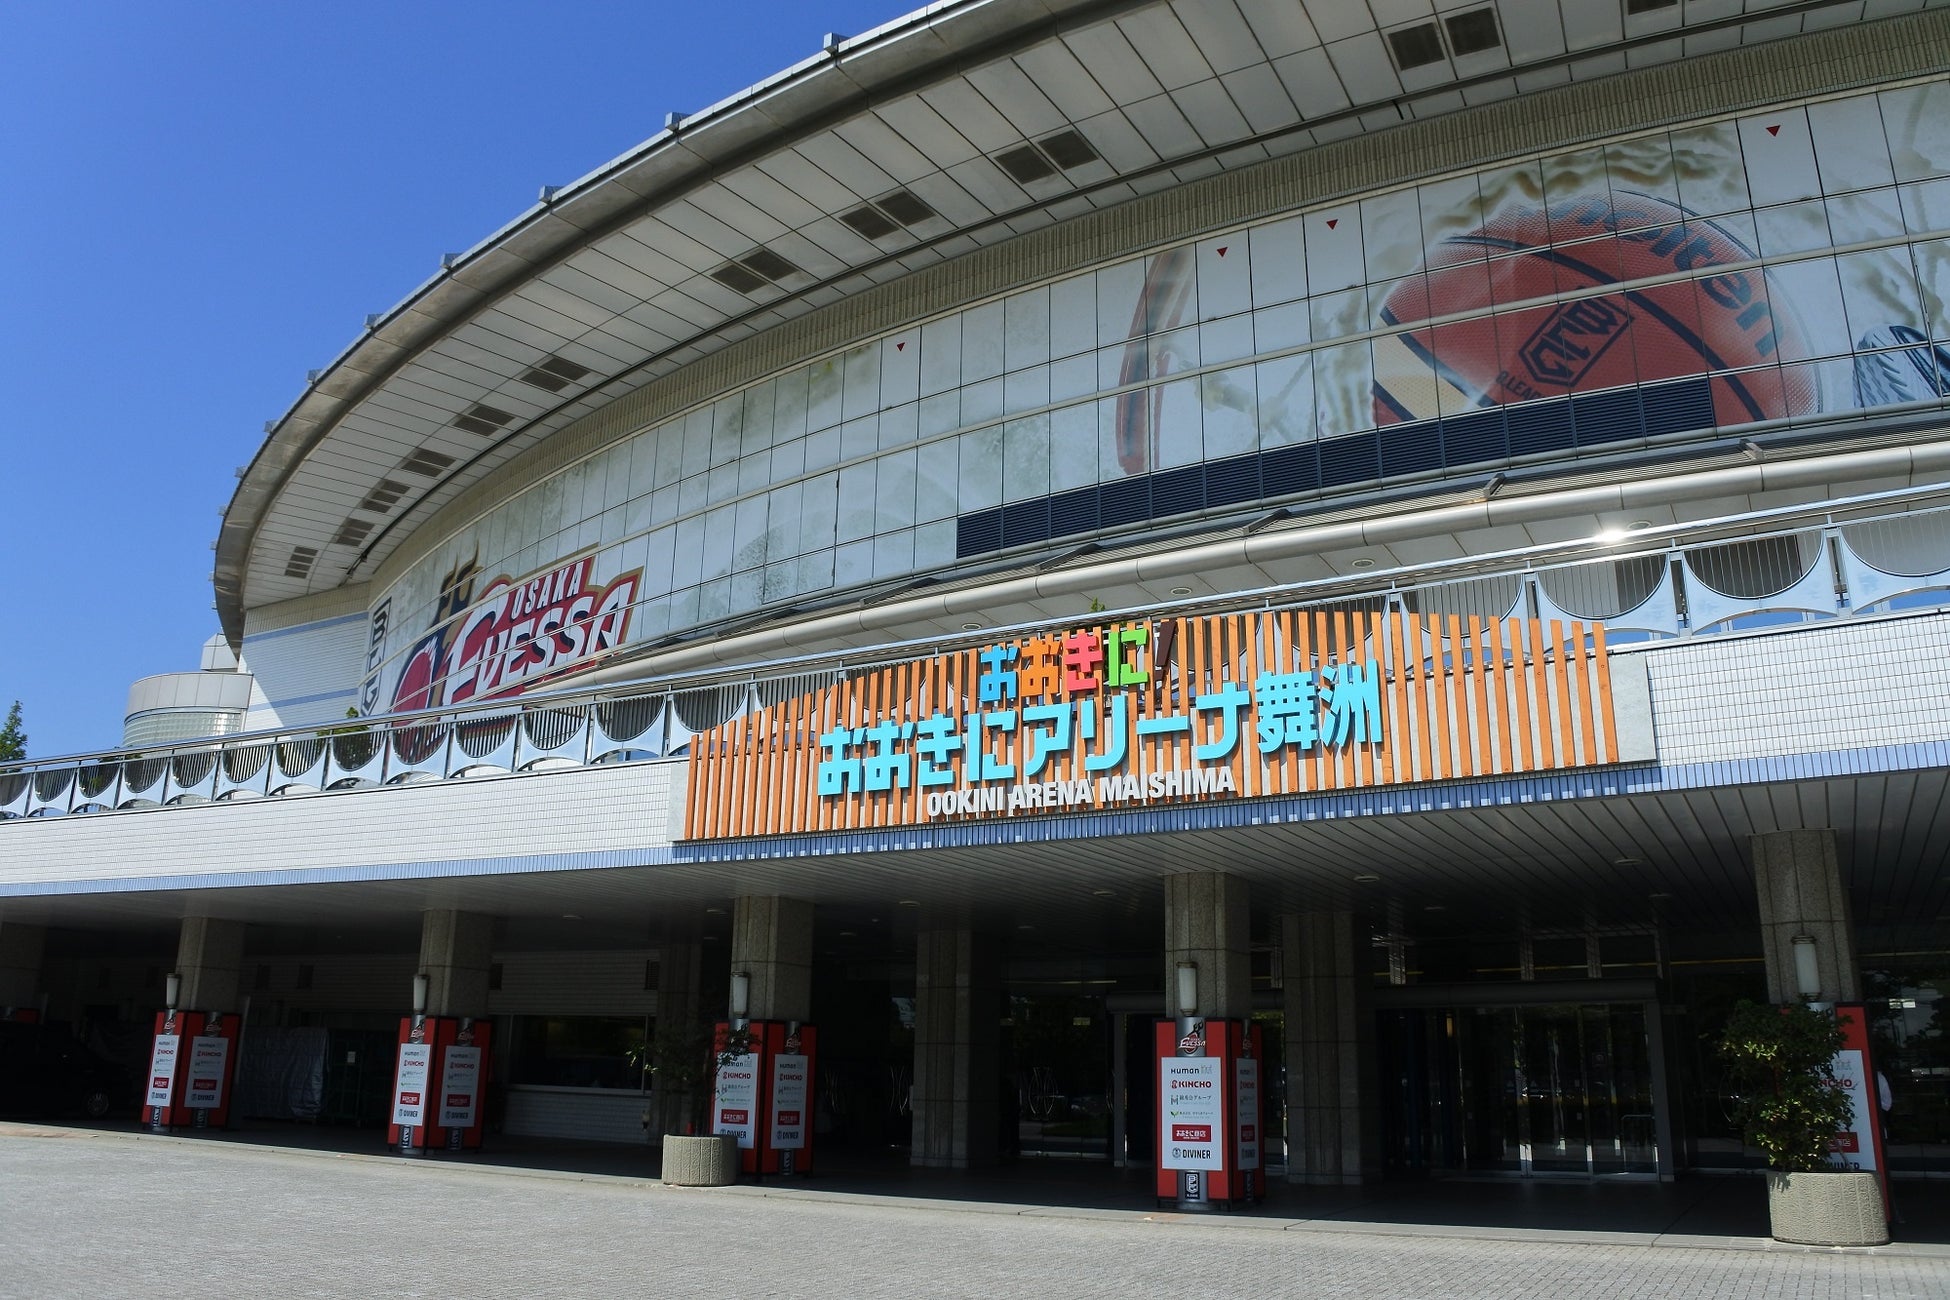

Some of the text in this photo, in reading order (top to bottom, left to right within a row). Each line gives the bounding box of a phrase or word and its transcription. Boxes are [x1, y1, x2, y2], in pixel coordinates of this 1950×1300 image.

[511, 561, 584, 621] OSAKA
[818, 659, 1382, 796] おおきにアリーナ舞洲
[927, 766, 1237, 817] OOKINI ARENA MAISHIMA
[1182, 1149, 1211, 1159] DIVINER
